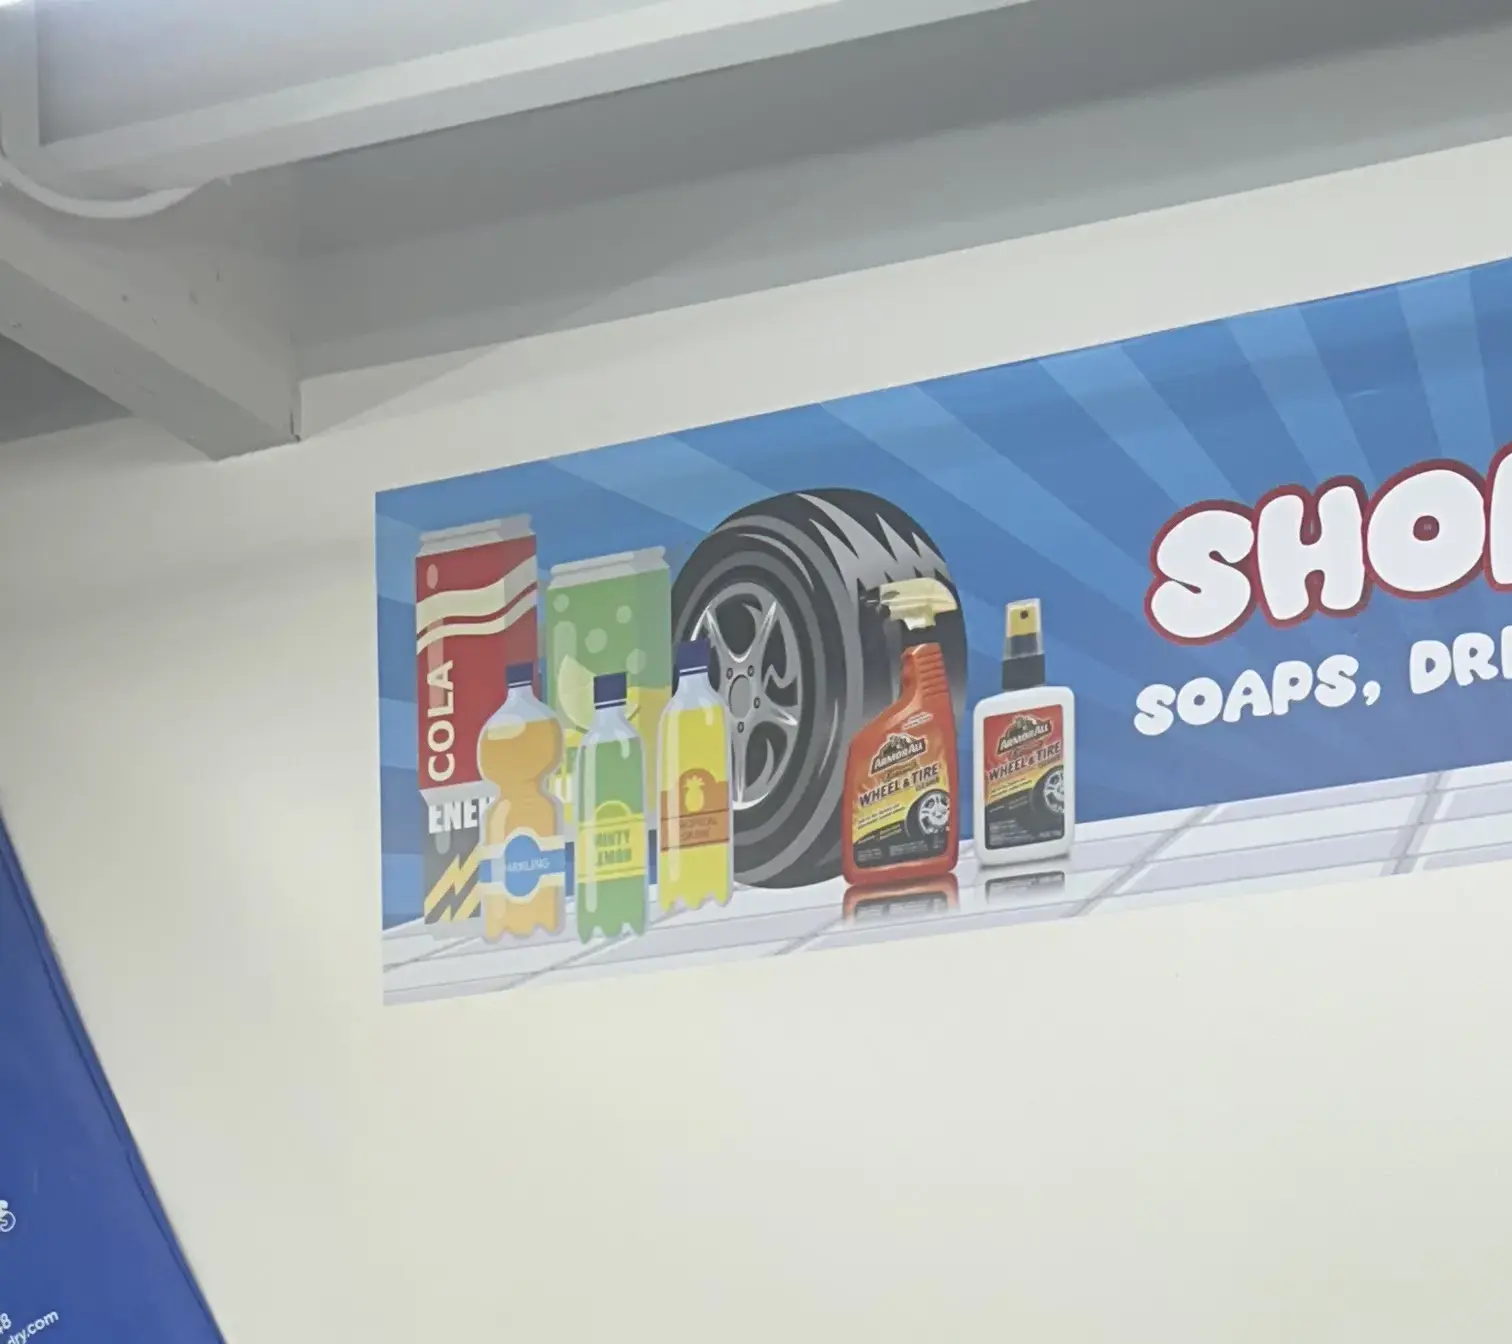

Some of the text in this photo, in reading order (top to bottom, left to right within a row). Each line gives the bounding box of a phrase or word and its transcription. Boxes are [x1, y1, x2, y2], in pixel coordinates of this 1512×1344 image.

[426, 660, 455, 782] COLA
[1133, 655, 1381, 736] SOAPS,
[860, 778, 900, 806] WHEEL
[912, 763, 939, 785] TIRE
[989, 759, 1026, 781] WHEEL
[1038, 742, 1062, 762] TIRE
